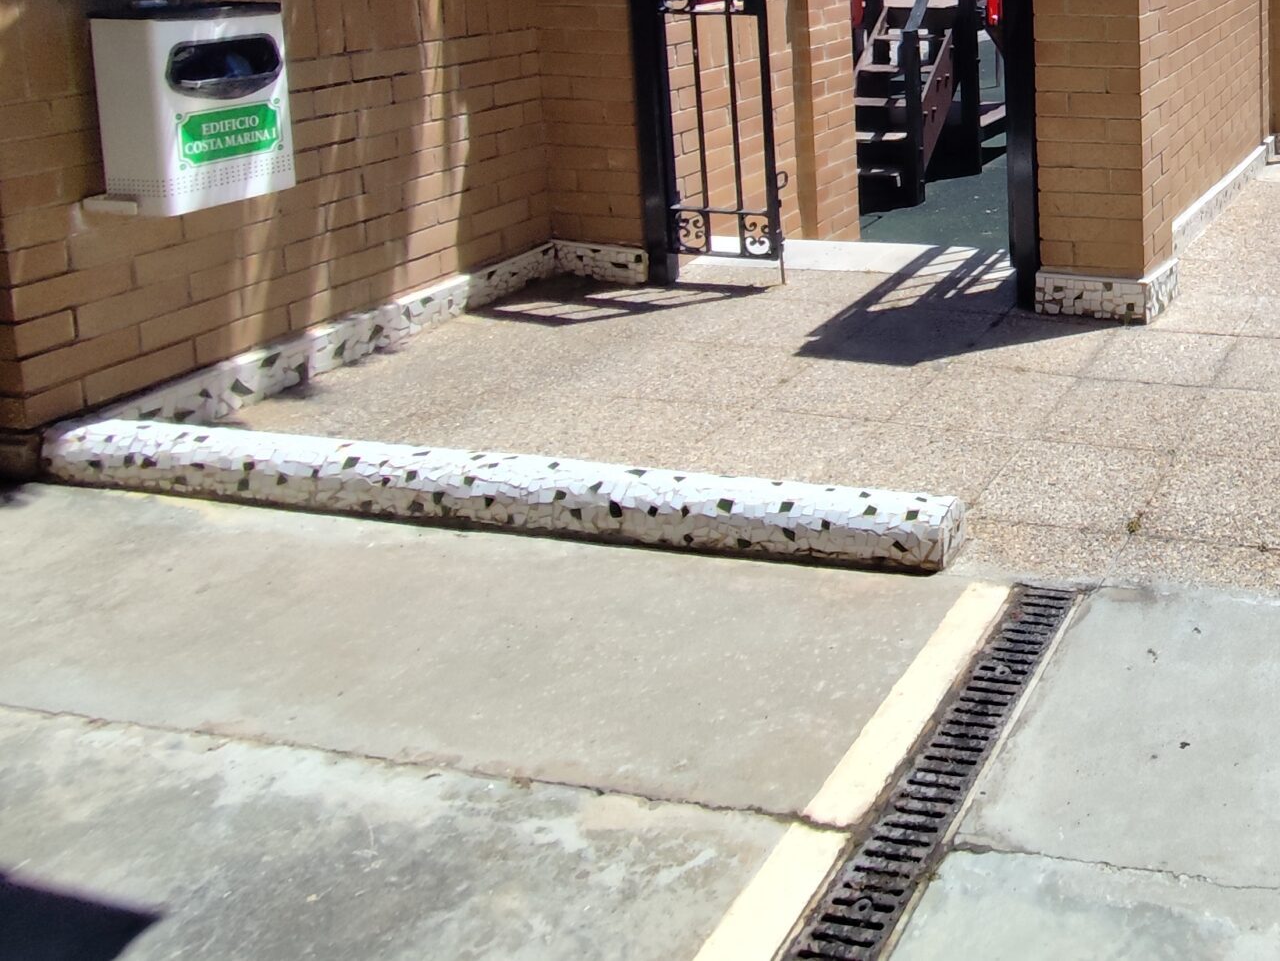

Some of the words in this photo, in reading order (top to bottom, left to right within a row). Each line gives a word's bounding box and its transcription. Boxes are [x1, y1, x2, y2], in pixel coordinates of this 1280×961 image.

[201, 115, 259, 136] EDIFICIO
[184, 136, 224, 155] COSTA
[224, 128, 271, 148] MARINA
[272, 126, 277, 139] I
